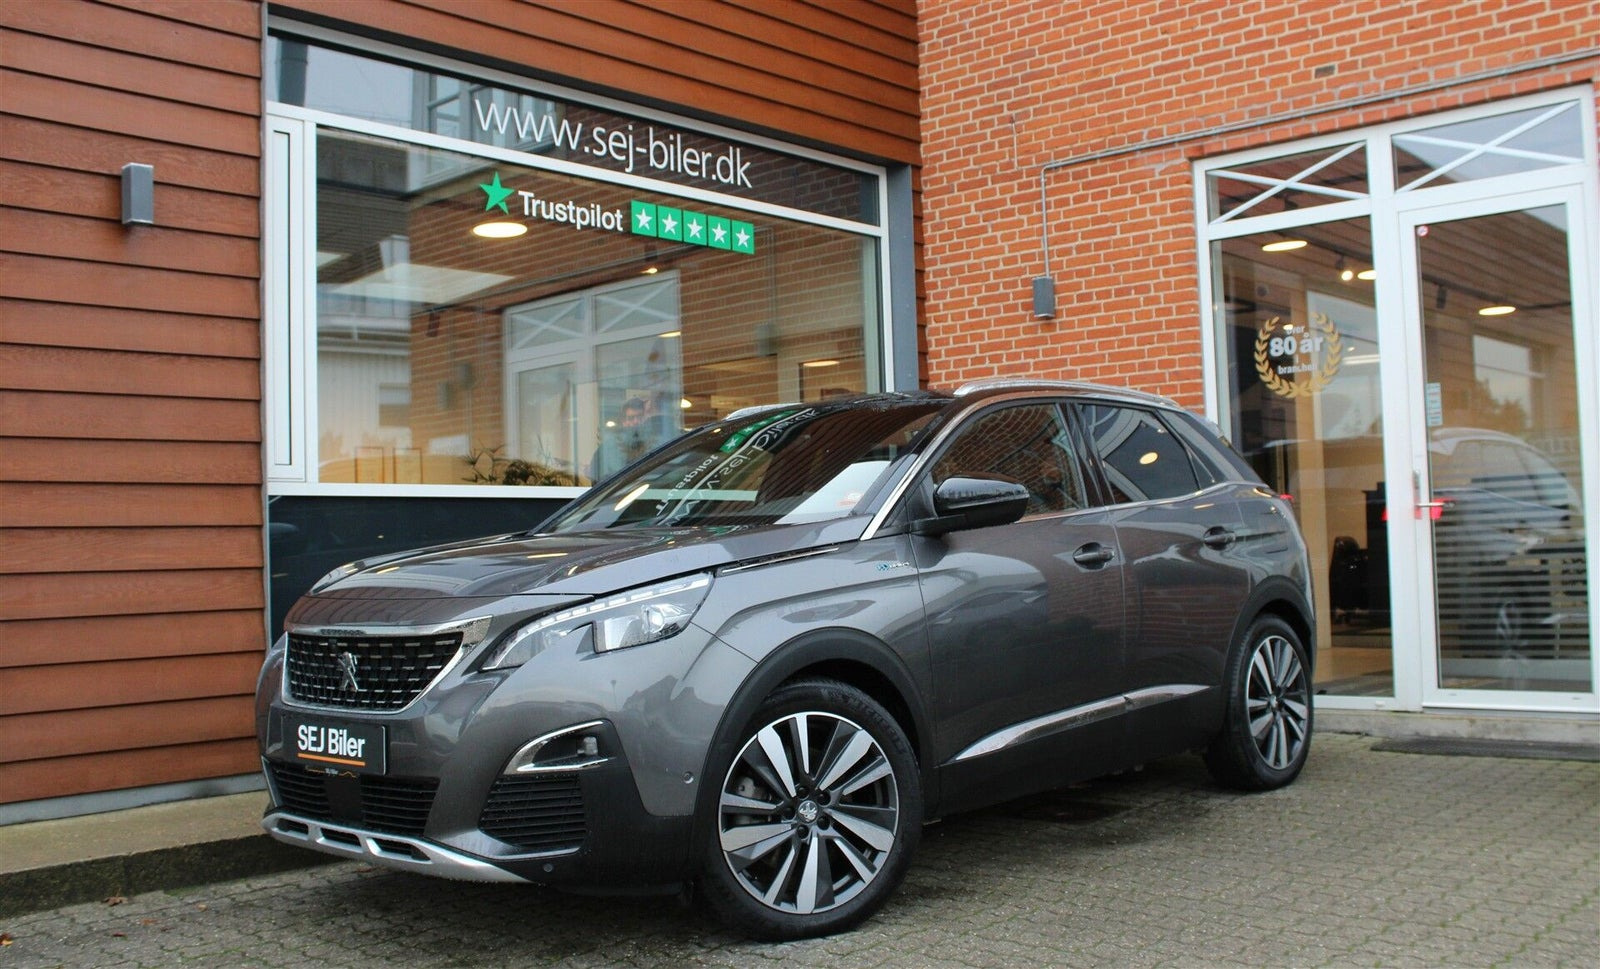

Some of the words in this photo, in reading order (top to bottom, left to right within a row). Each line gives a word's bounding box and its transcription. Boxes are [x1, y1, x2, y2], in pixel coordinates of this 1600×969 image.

[474, 98, 752, 188] www.sej-biler.dk
[518, 190, 623, 232] Trustpilot
[1270, 336, 1297, 357] 80
[1300, 332, 1324, 353] år
[297, 724, 325, 753] SEJ
[328, 728, 365, 758] Biler
